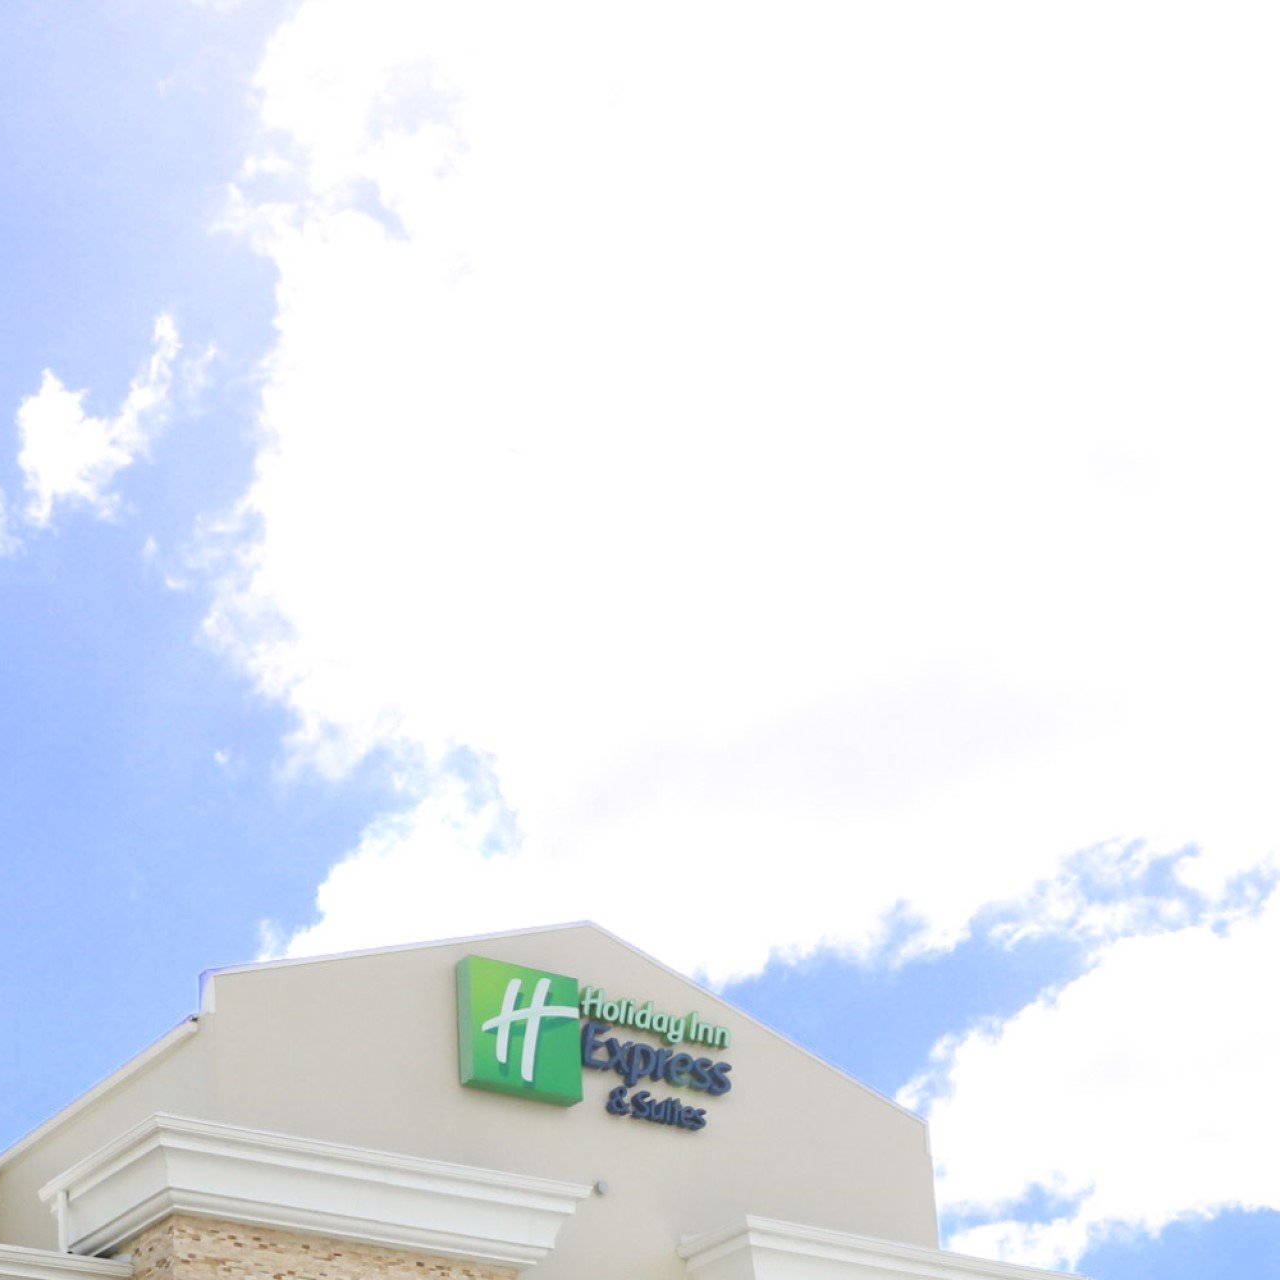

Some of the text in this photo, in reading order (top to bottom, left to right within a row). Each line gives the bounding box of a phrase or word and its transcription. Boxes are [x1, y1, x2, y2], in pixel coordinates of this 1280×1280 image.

[580, 985, 731, 1048] Holiday Inn
[581, 1022, 733, 1096] Express
[606, 1085, 707, 1131] & Suites
